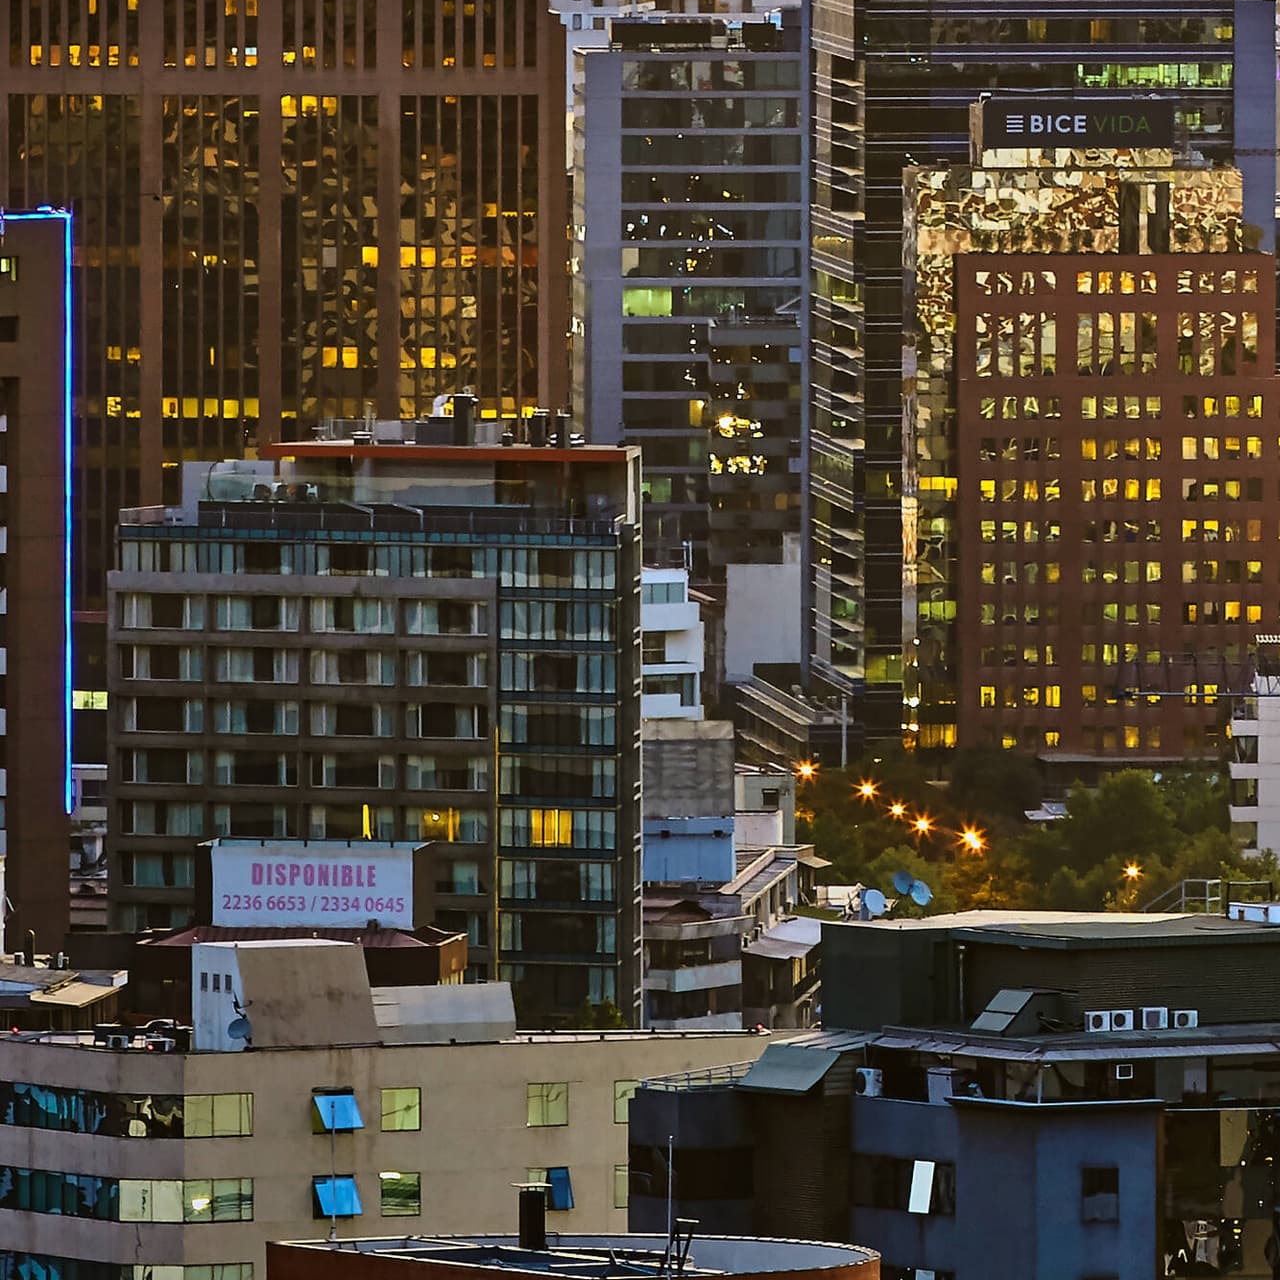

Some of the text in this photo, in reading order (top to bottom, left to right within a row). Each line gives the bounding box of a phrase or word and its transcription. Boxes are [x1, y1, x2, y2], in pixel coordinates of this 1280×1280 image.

[1030, 115, 1153, 133] BICE VIDA
[251, 863, 377, 887] DISPONIBLE
[222, 895, 405, 913] 2236 6653 / 2334 0645
